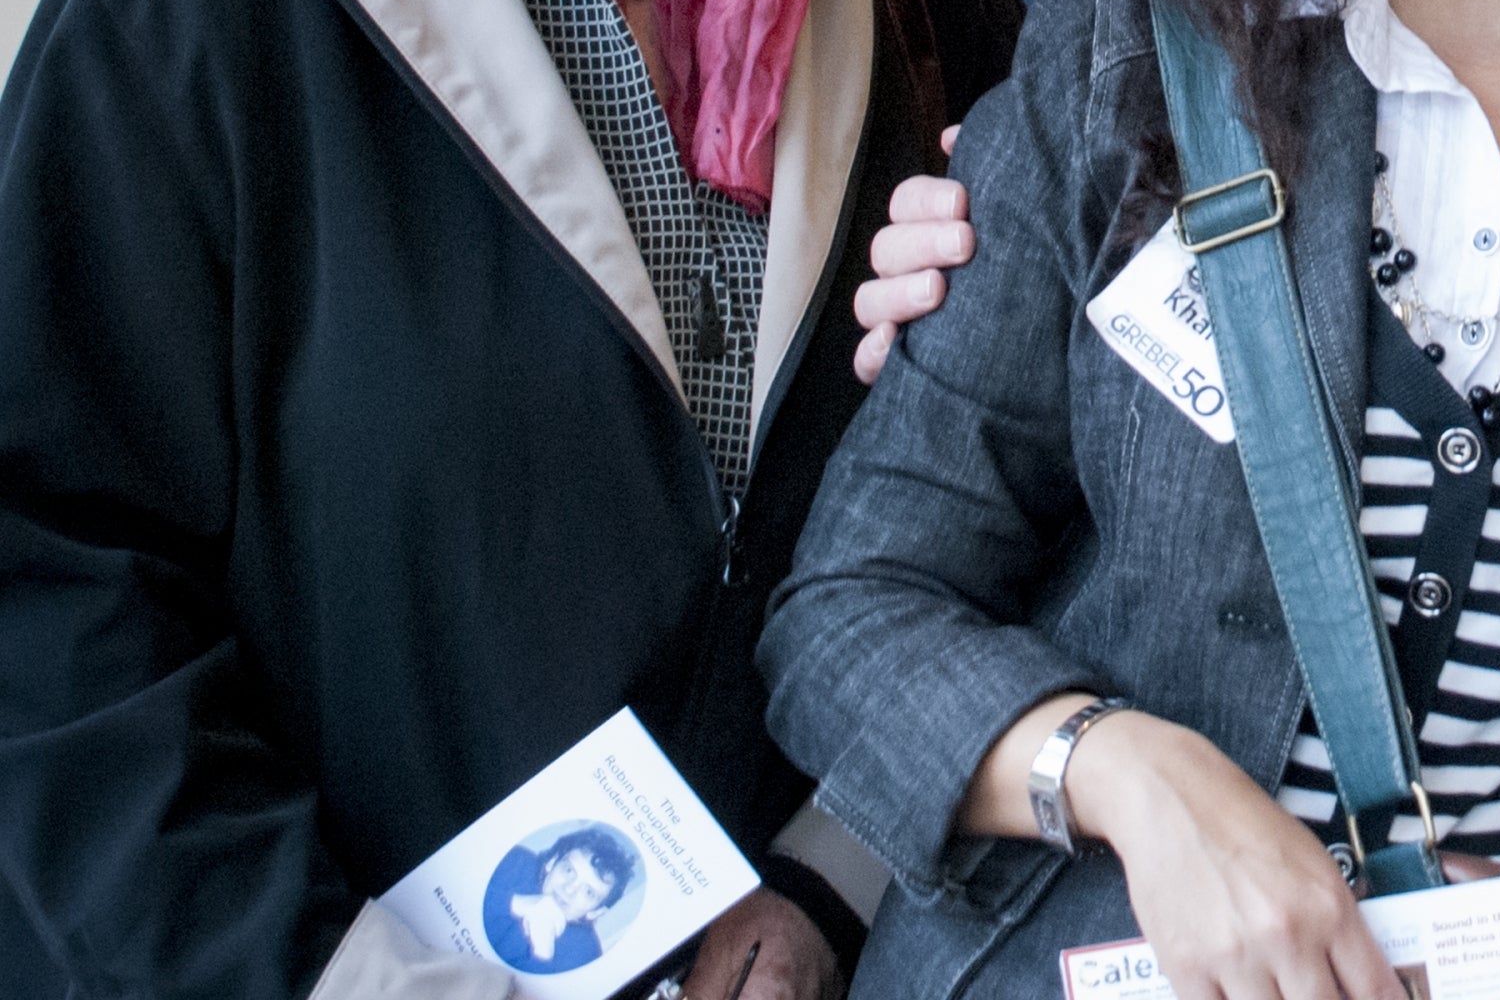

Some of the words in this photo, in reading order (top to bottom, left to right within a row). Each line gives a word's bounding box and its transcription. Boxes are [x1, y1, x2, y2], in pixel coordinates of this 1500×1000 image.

[604, 754, 635, 794] Robin
[634, 794, 685, 856] Coupland
[683, 857, 710, 888] Jutzi
[660, 797, 681, 825] The
[593, 767, 635, 821] Student
[634, 821, 694, 896] Scholarship
[434, 886, 461, 927] Robin
[1432, 916, 1473, 933] Sound
[1477, 914, 1489, 925] in
[1435, 936, 1458, 950] will
[1461, 931, 1496, 946] focus
[1437, 953, 1459, 967] the
